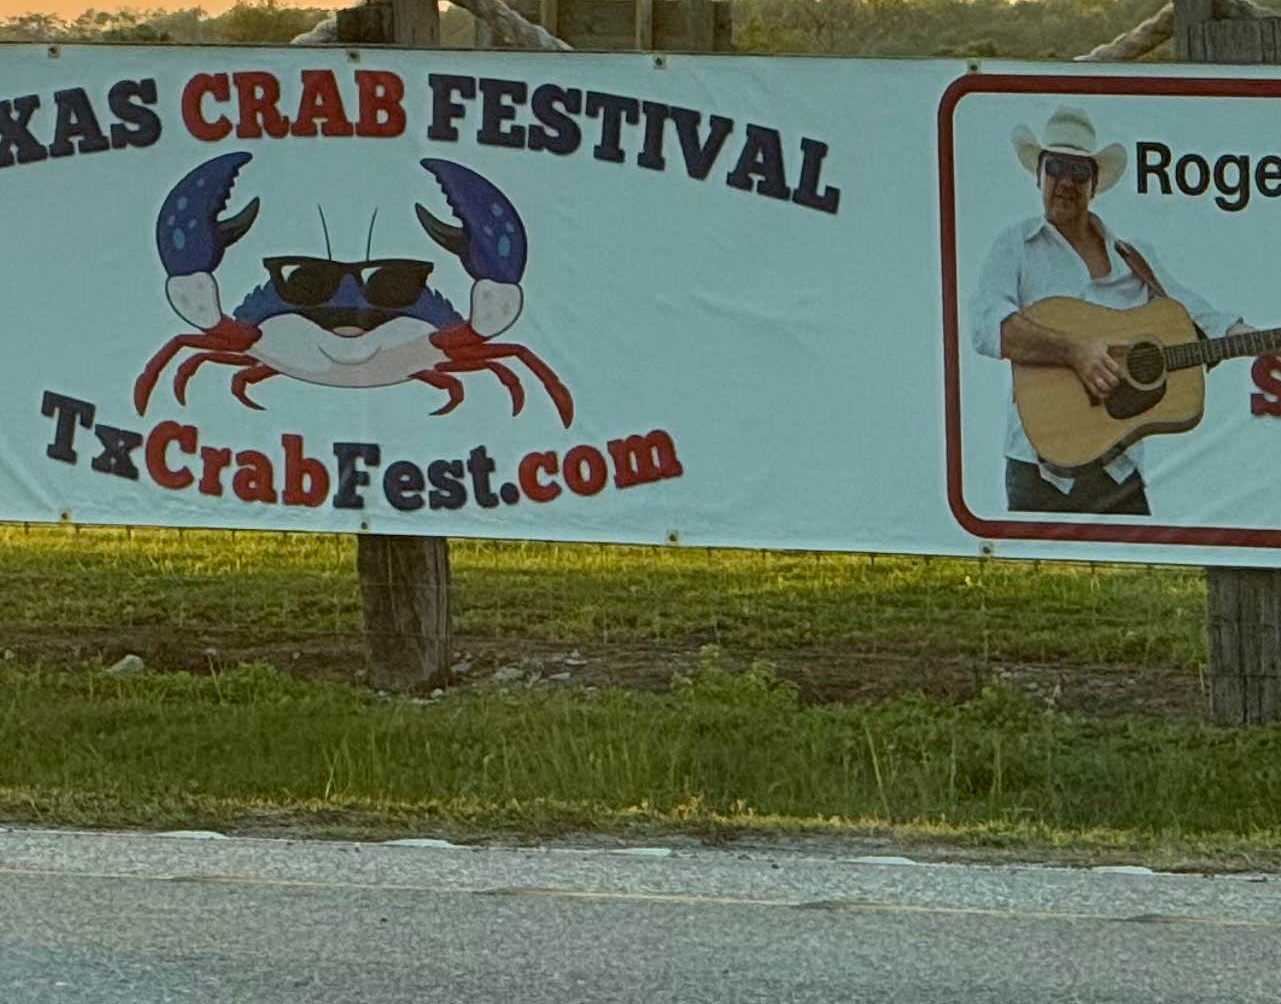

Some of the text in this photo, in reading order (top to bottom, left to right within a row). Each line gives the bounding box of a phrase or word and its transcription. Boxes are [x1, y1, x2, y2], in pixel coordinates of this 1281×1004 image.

[179, 69, 408, 140] CRAB
[426, 73, 842, 214] FESTIVAL
[40, 390, 684, 511] TxCrabFest.com
